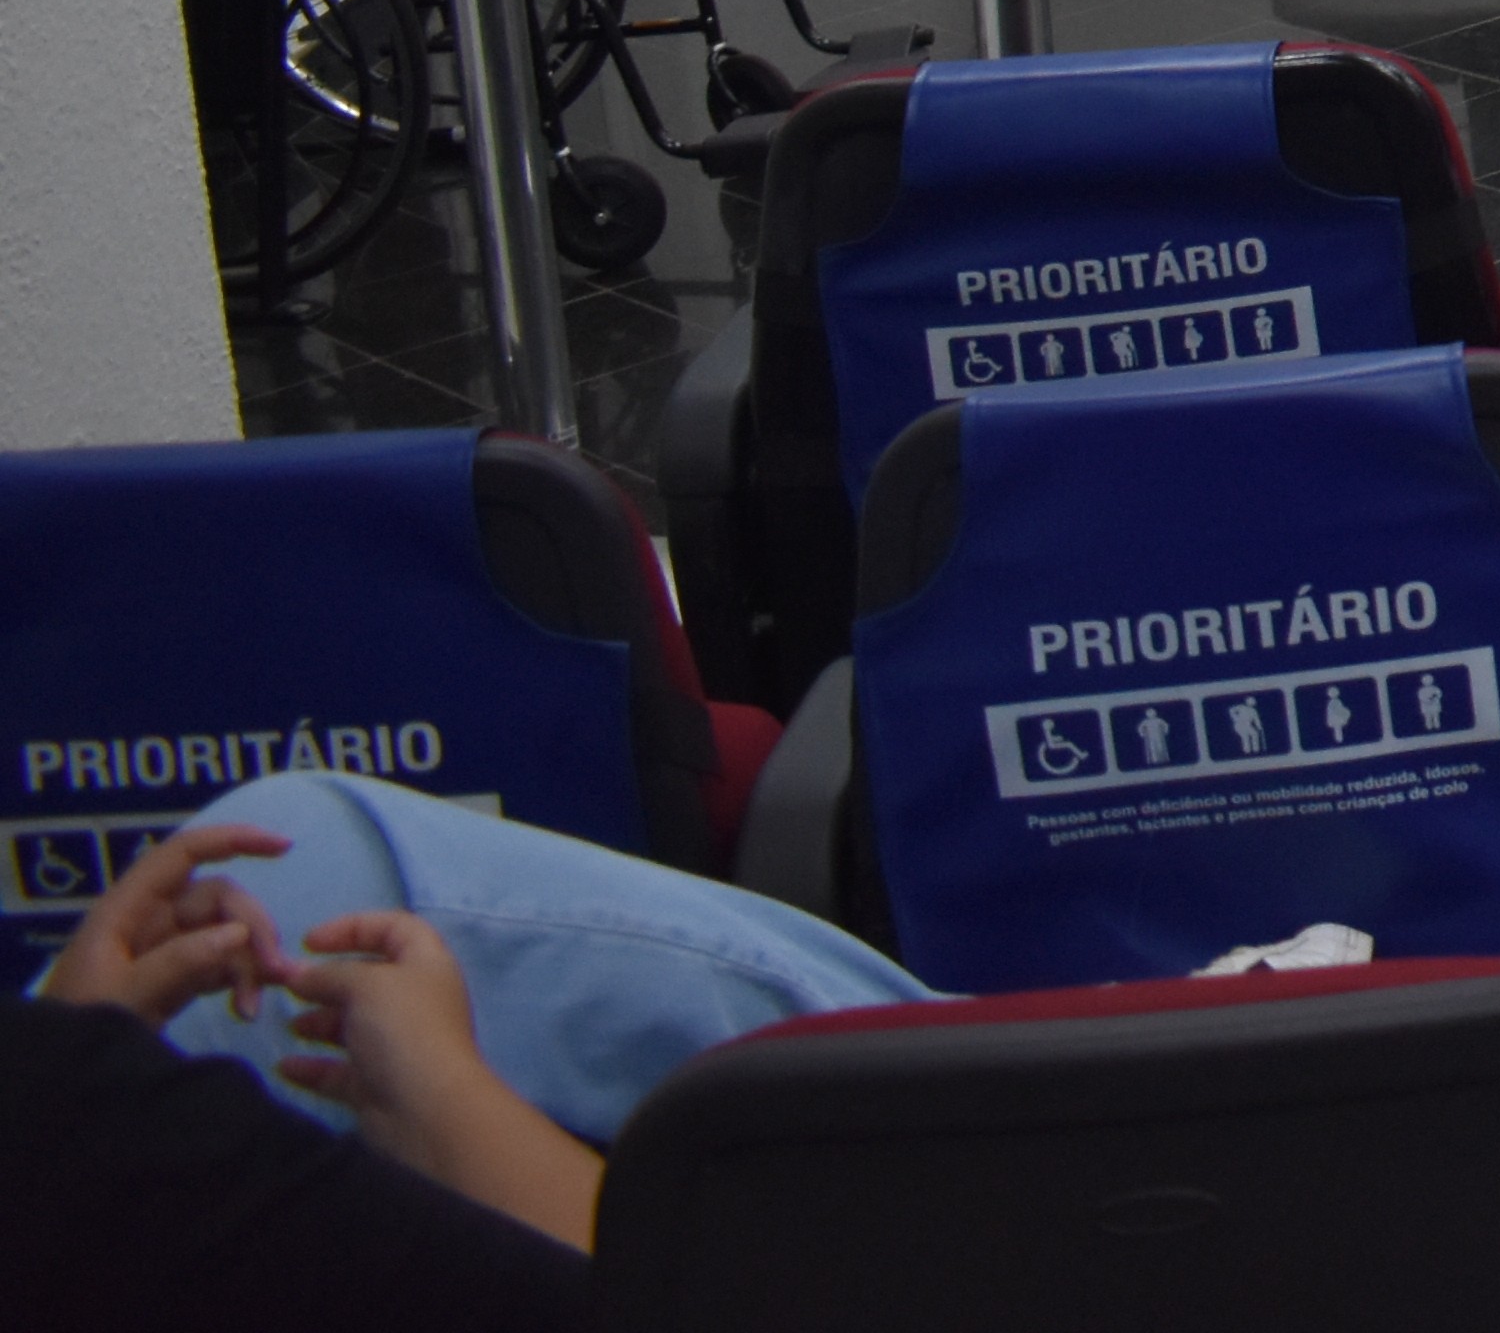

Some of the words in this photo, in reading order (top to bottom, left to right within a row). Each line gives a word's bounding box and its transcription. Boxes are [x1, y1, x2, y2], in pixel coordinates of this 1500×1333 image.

[956, 237, 1268, 307] PRIORITÁRIO
[1028, 581, 1438, 674] PRIORITÁRIO
[22, 717, 443, 793] PRIORITÁRIO
[1027, 810, 1097, 829] Pessoas
[1101, 805, 1137, 820] com
[1140, 794, 1227, 815] deficiência
[1231, 791, 1252, 804] ou
[1256, 782, 1343, 803] mobilidade
[1347, 770, 1422, 793] reduzida,
[1049, 823, 1134, 847] gestantes,
[1137, 812, 1210, 831] lactantes
[1214, 813, 1224, 823] e
[1228, 803, 1295, 825] pessoas
[1298, 800, 1334, 815] com
[1337, 791, 1405, 811] crianças
[1408, 785, 1430, 801] de
[1433, 779, 1469, 796] colo
